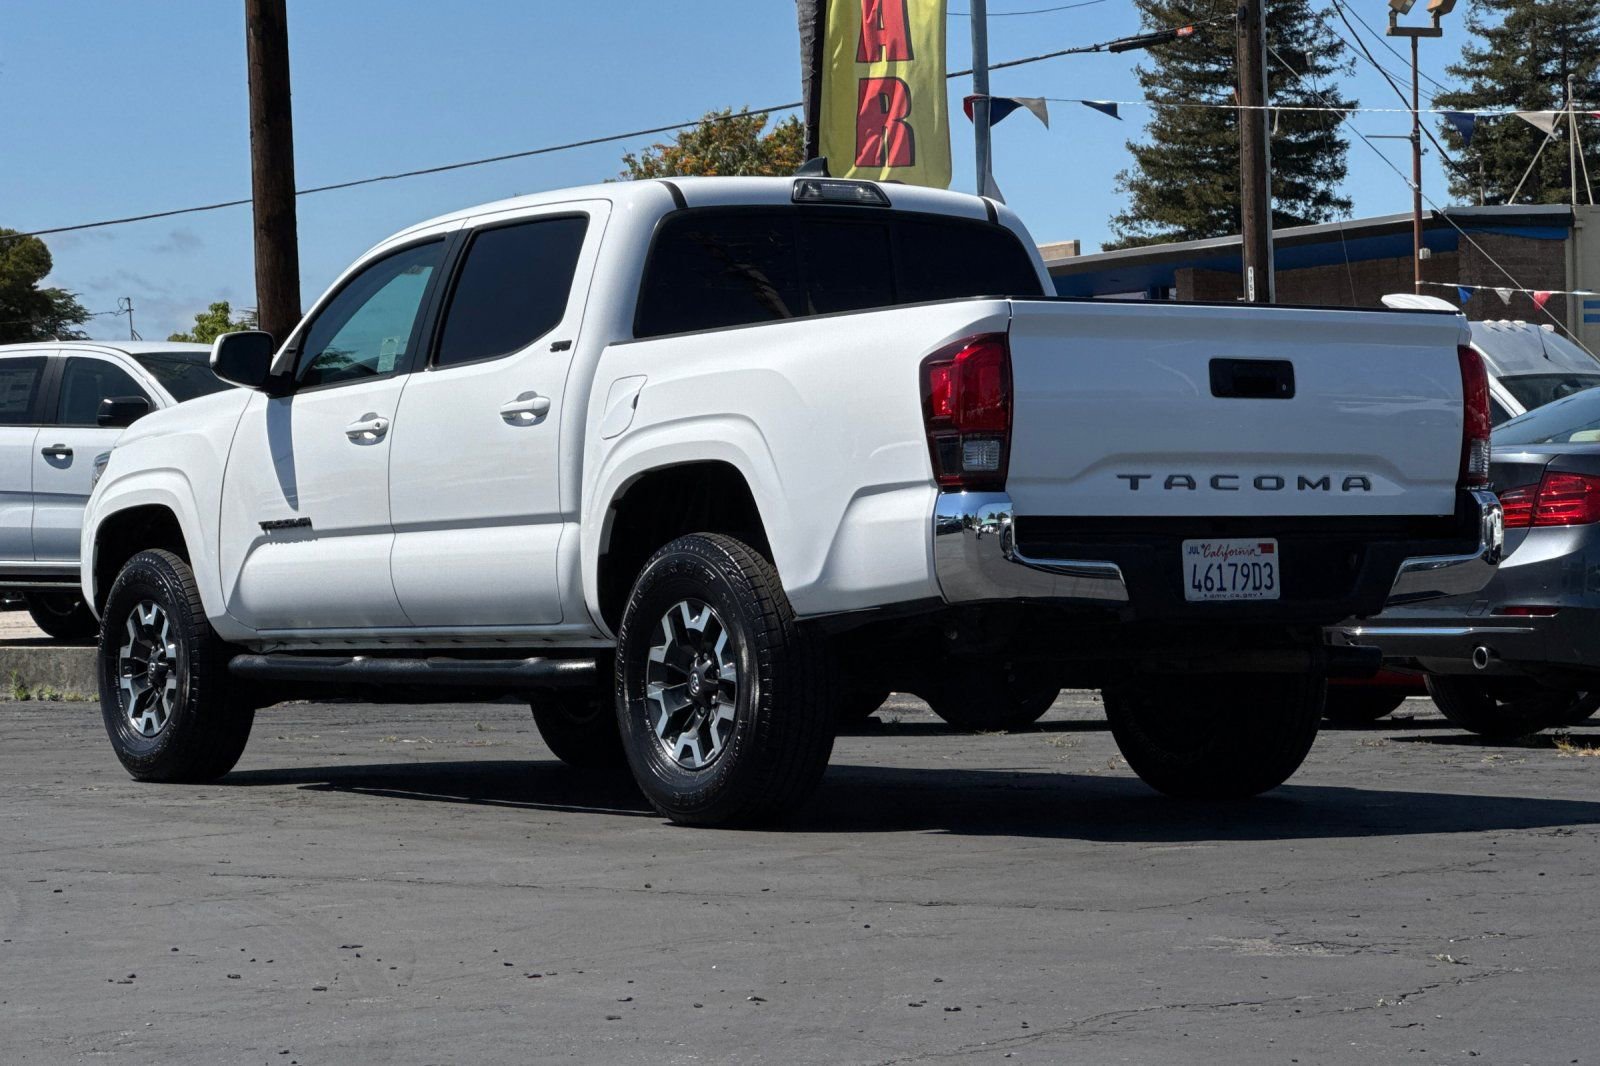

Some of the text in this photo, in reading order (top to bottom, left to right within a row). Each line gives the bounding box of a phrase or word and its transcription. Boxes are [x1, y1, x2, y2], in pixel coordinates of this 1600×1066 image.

[855, 0, 915, 168] AR
[1116, 474, 1372, 491] TACOMA
[1188, 546, 1200, 555] JUL
[1202, 544, 1260, 561] California
[1192, 562, 1274, 592] 46179D3
